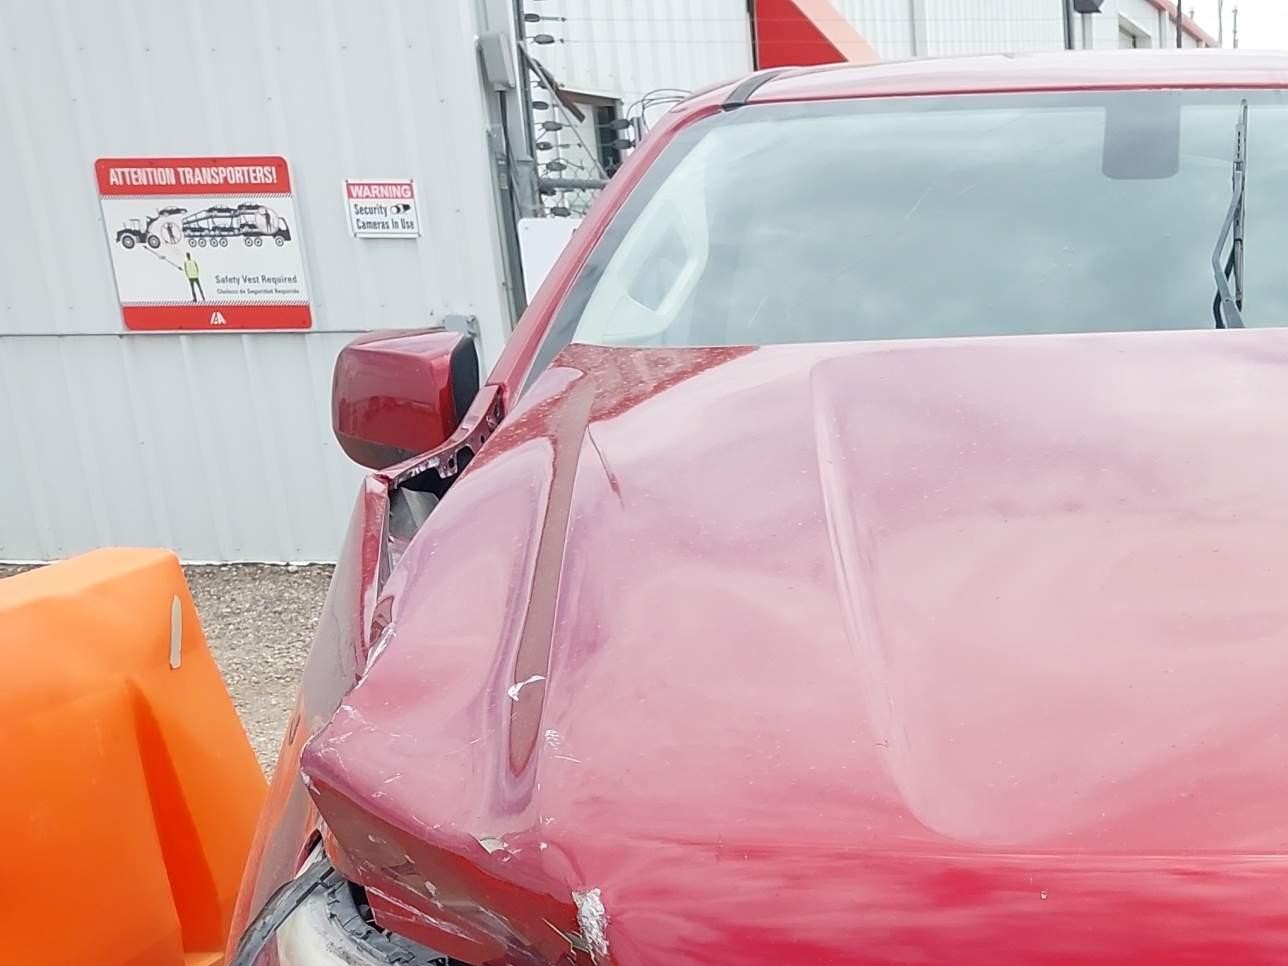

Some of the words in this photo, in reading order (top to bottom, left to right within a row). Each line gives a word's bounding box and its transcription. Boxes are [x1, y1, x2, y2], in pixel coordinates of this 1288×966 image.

[109, 168, 176, 185] ATTENTION
[177, 166, 277, 185] TRANSPORTERS!
[350, 185, 411, 198] WARNING
[354, 203, 387, 217] Security
[356, 218, 389, 230] Cameras
[391, 218, 399, 230] In
[400, 218, 414, 230] Use
[215, 274, 240, 285] Safety
[241, 274, 260, 284] Vest
[261, 274, 297, 285] Required
